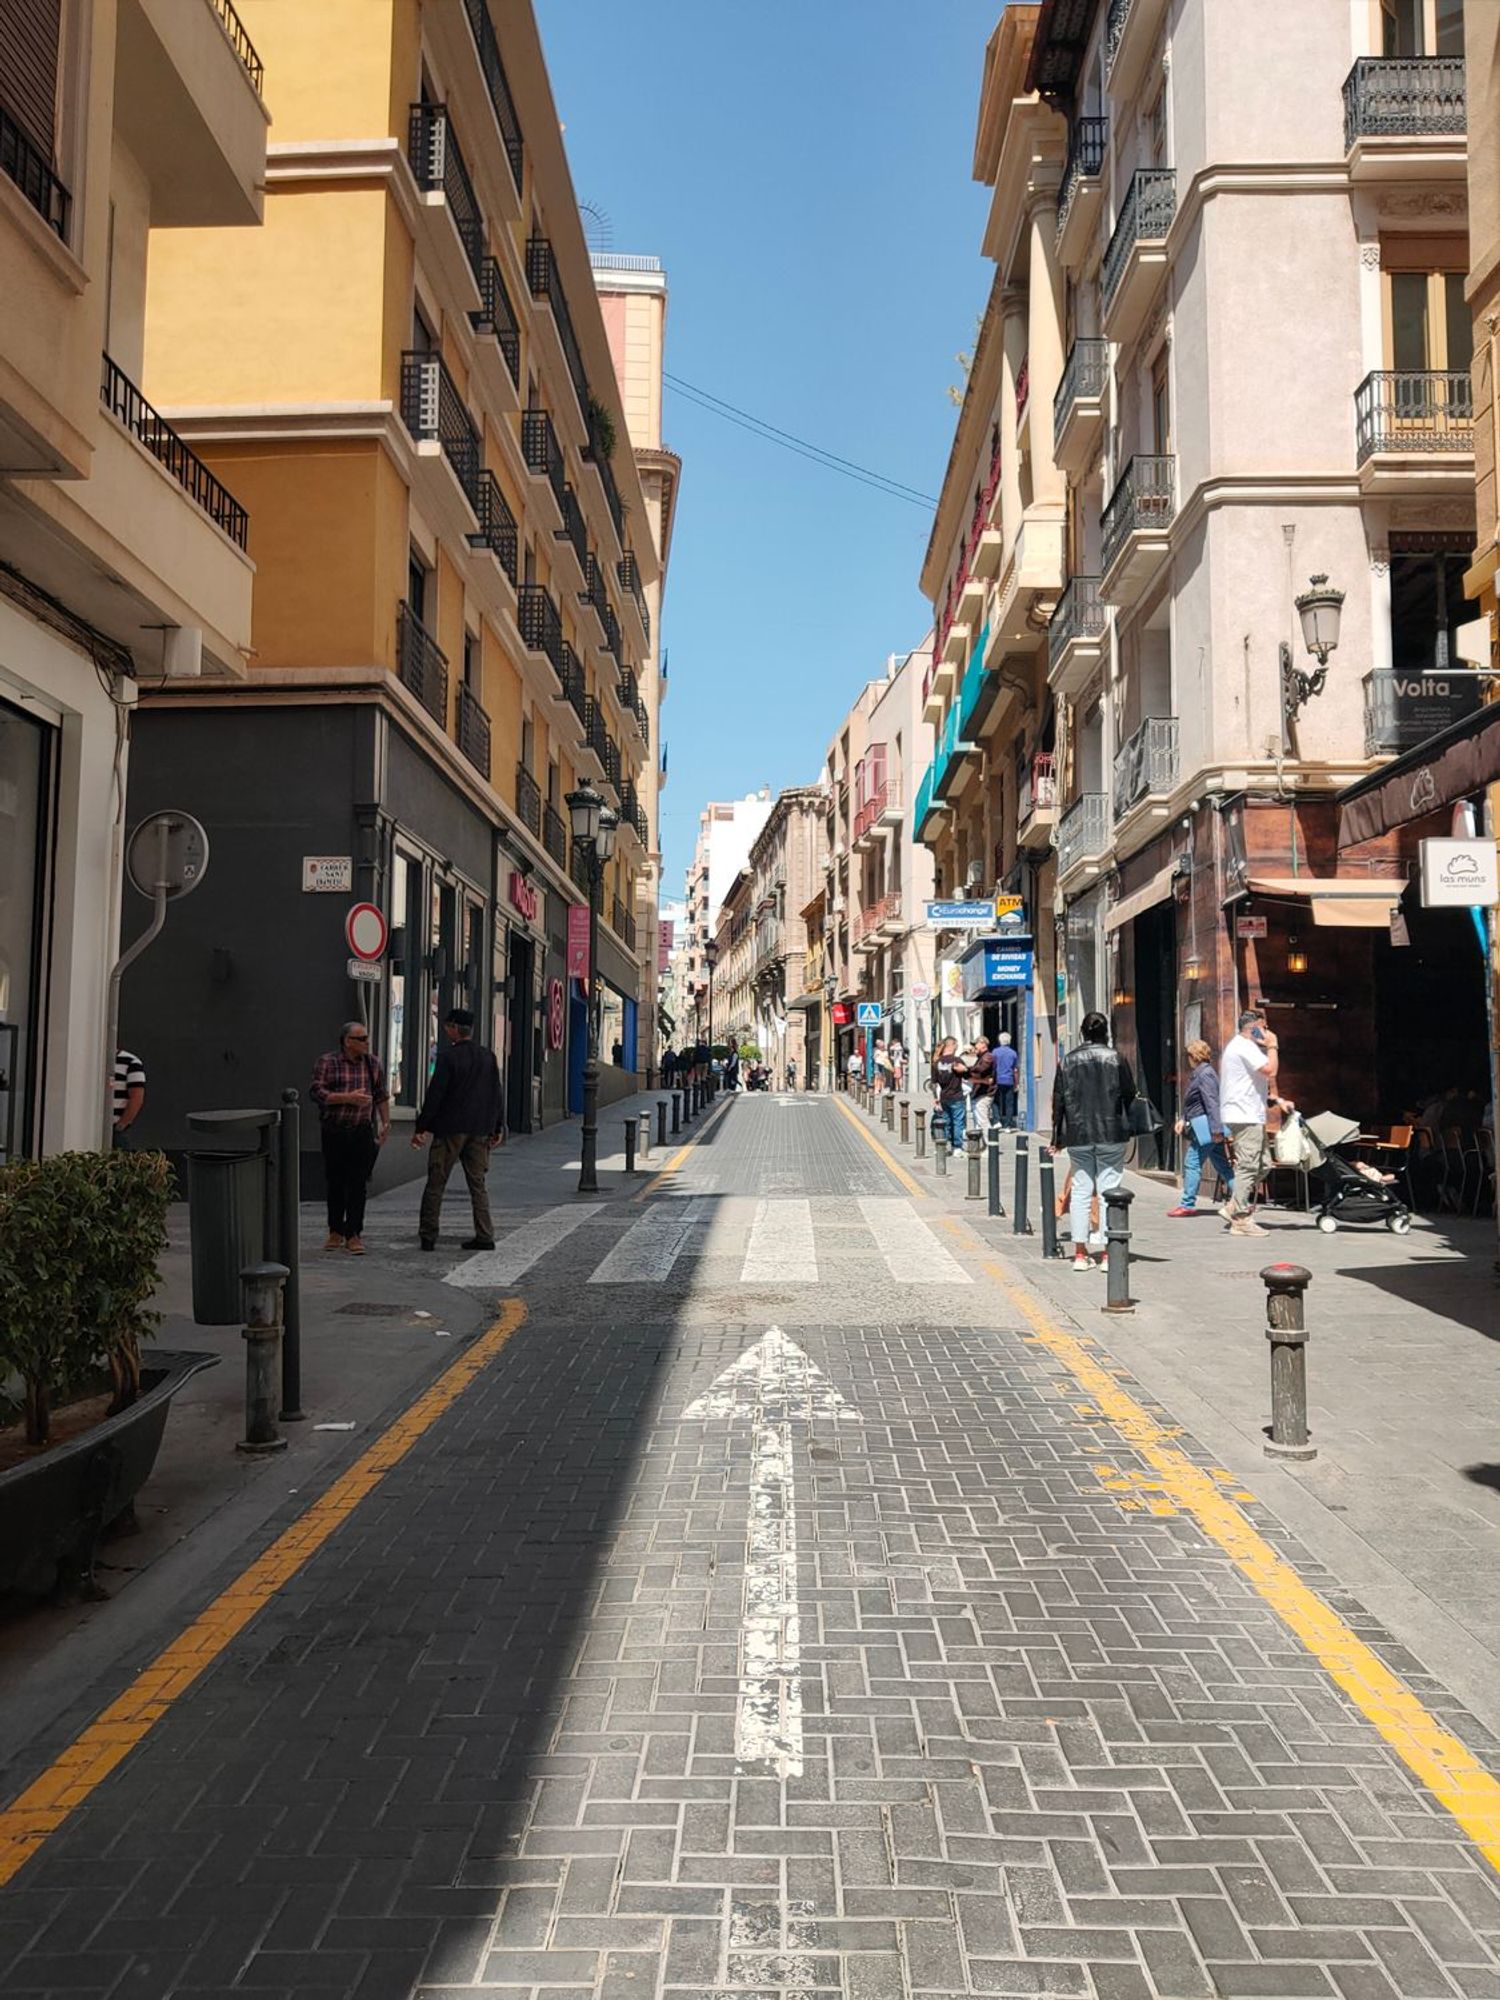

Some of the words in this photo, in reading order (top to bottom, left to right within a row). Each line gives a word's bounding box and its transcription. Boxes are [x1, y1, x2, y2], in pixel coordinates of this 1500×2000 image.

[1440, 873, 1455, 883] las
[1457, 875, 1487, 883] muns
[999, 898, 1024, 907] ATM
[991, 953, 1001, 961] DE
[1001, 953, 1027, 961] DIVISAS
